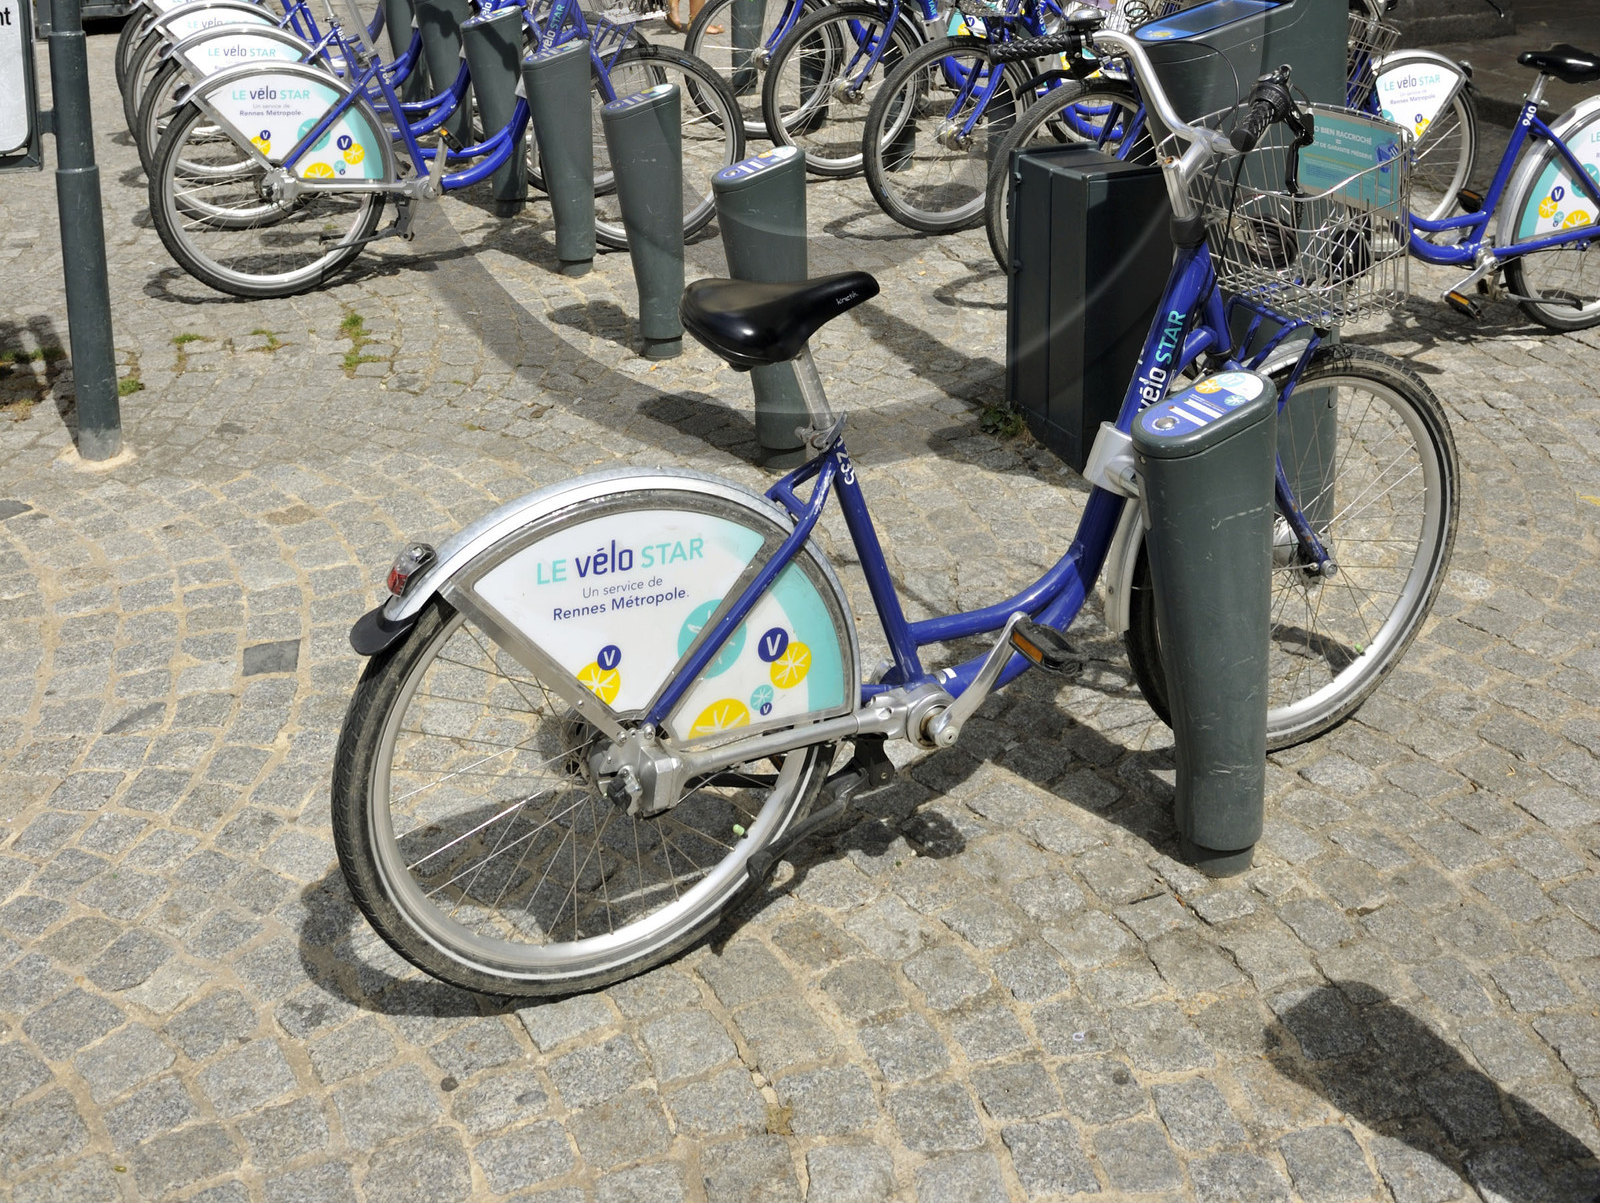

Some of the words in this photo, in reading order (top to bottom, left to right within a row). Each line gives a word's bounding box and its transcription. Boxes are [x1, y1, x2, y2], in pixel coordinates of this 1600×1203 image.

[550, 4, 566, 30] STAR
[207, 48, 220, 57] LE
[223, 44, 247, 57] vélo
[249, 48, 277, 57] STAR
[232, 89, 246, 100] LE
[249, 85, 277, 100] vélo
[280, 89, 310, 100] STAR
[1384, 81, 1395, 92] LE
[1396, 73, 1417, 90] vélo
[1418, 74, 1441, 87] STAR
[1521, 105, 1537, 127] 940
[1320, 125, 1335, 136] BIEN
[1335, 129, 1373, 146] RACCROCHÉ
[1154, 309, 1187, 367] STAR
[536, 559, 568, 586] LE
[574, 538, 634, 580] vélo
[640, 537, 705, 570] STAR
[582, 586, 600, 600] Un
[602, 580, 646, 597] service
[646, 574, 664, 590] de
[552, 602, 607, 622] Rennes
